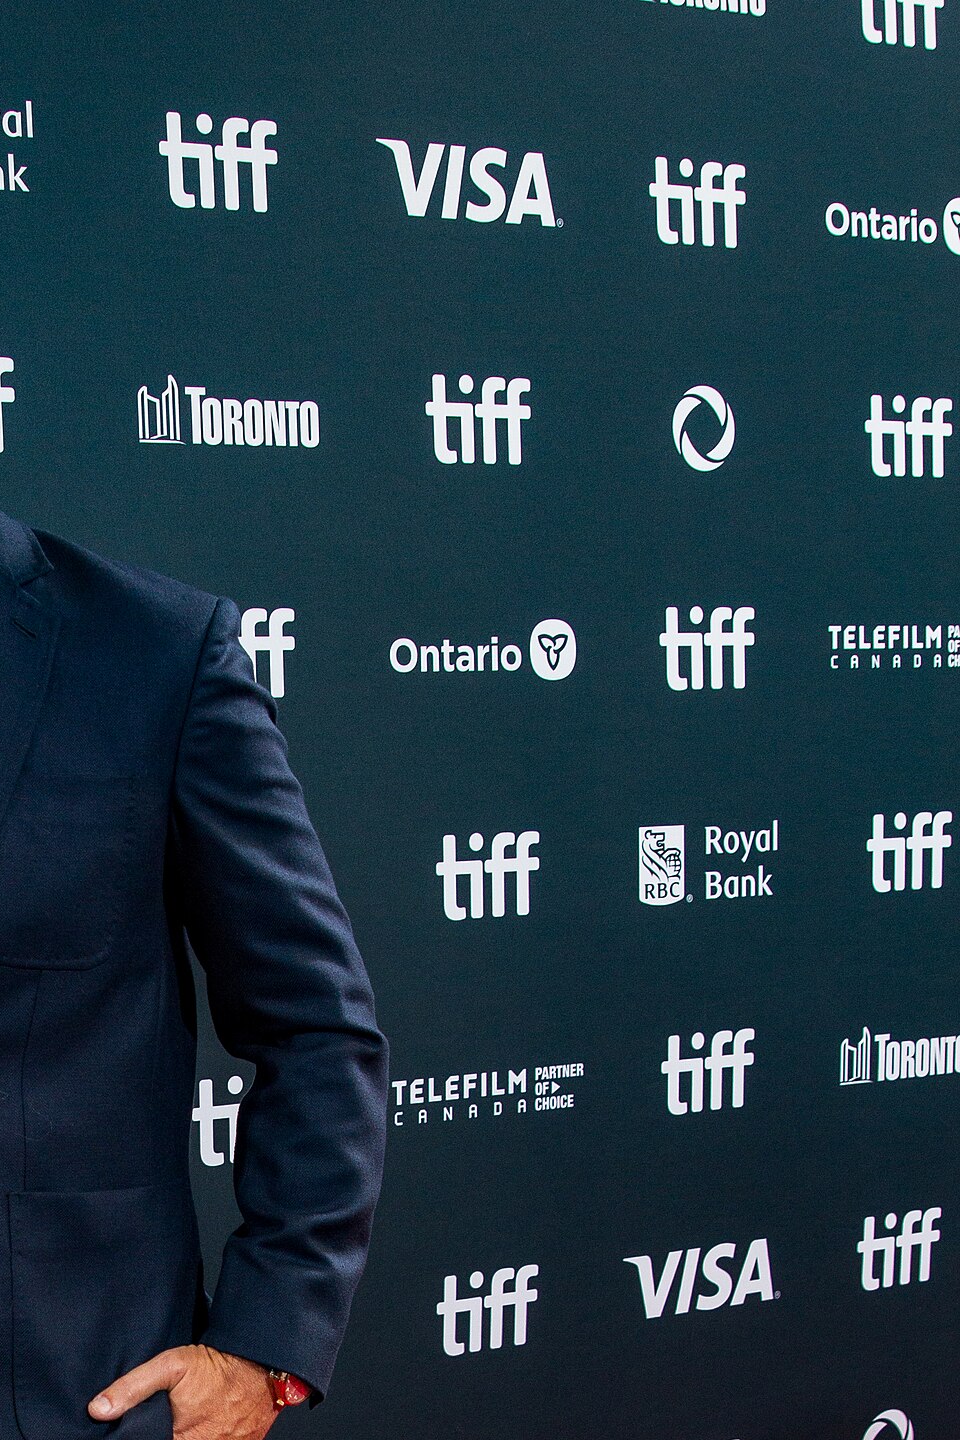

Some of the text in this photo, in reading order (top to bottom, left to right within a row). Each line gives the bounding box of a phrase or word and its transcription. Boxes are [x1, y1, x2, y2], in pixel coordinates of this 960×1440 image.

[158, 111, 279, 213] tiff
[375, 138, 557, 227] VISA
[648, 156, 747, 249] tiff
[825, 202, 939, 244] Ontario
[184, 386, 321, 448] TORONTO
[424, 373, 532, 466] tiff
[864, 394, 953, 478] tiff
[389, 636, 523, 674] Ontario
[658, 605, 756, 692] tiff
[827, 624, 943, 650] TELEFILM
[830, 653, 943, 669] CANADA
[704, 819, 779, 863] Royal
[866, 810, 953, 893] tiff
[435, 830, 540, 921] tiff
[644, 881, 681, 900] RBC
[704, 864, 774, 900] Bank
[392, 1068, 527, 1106] TELEFILM
[535, 1063, 584, 1081] PARTNER
[535, 1082, 550, 1096] OF
[660, 1027, 756, 1116] tiff
[394, 1098, 527, 1127] CANADA
[535, 1094, 575, 1112] CHOICE
[622, 1237, 774, 1320] VISA
[856, 1206, 942, 1291] tiff
[436, 1263, 539, 1357] tiff
